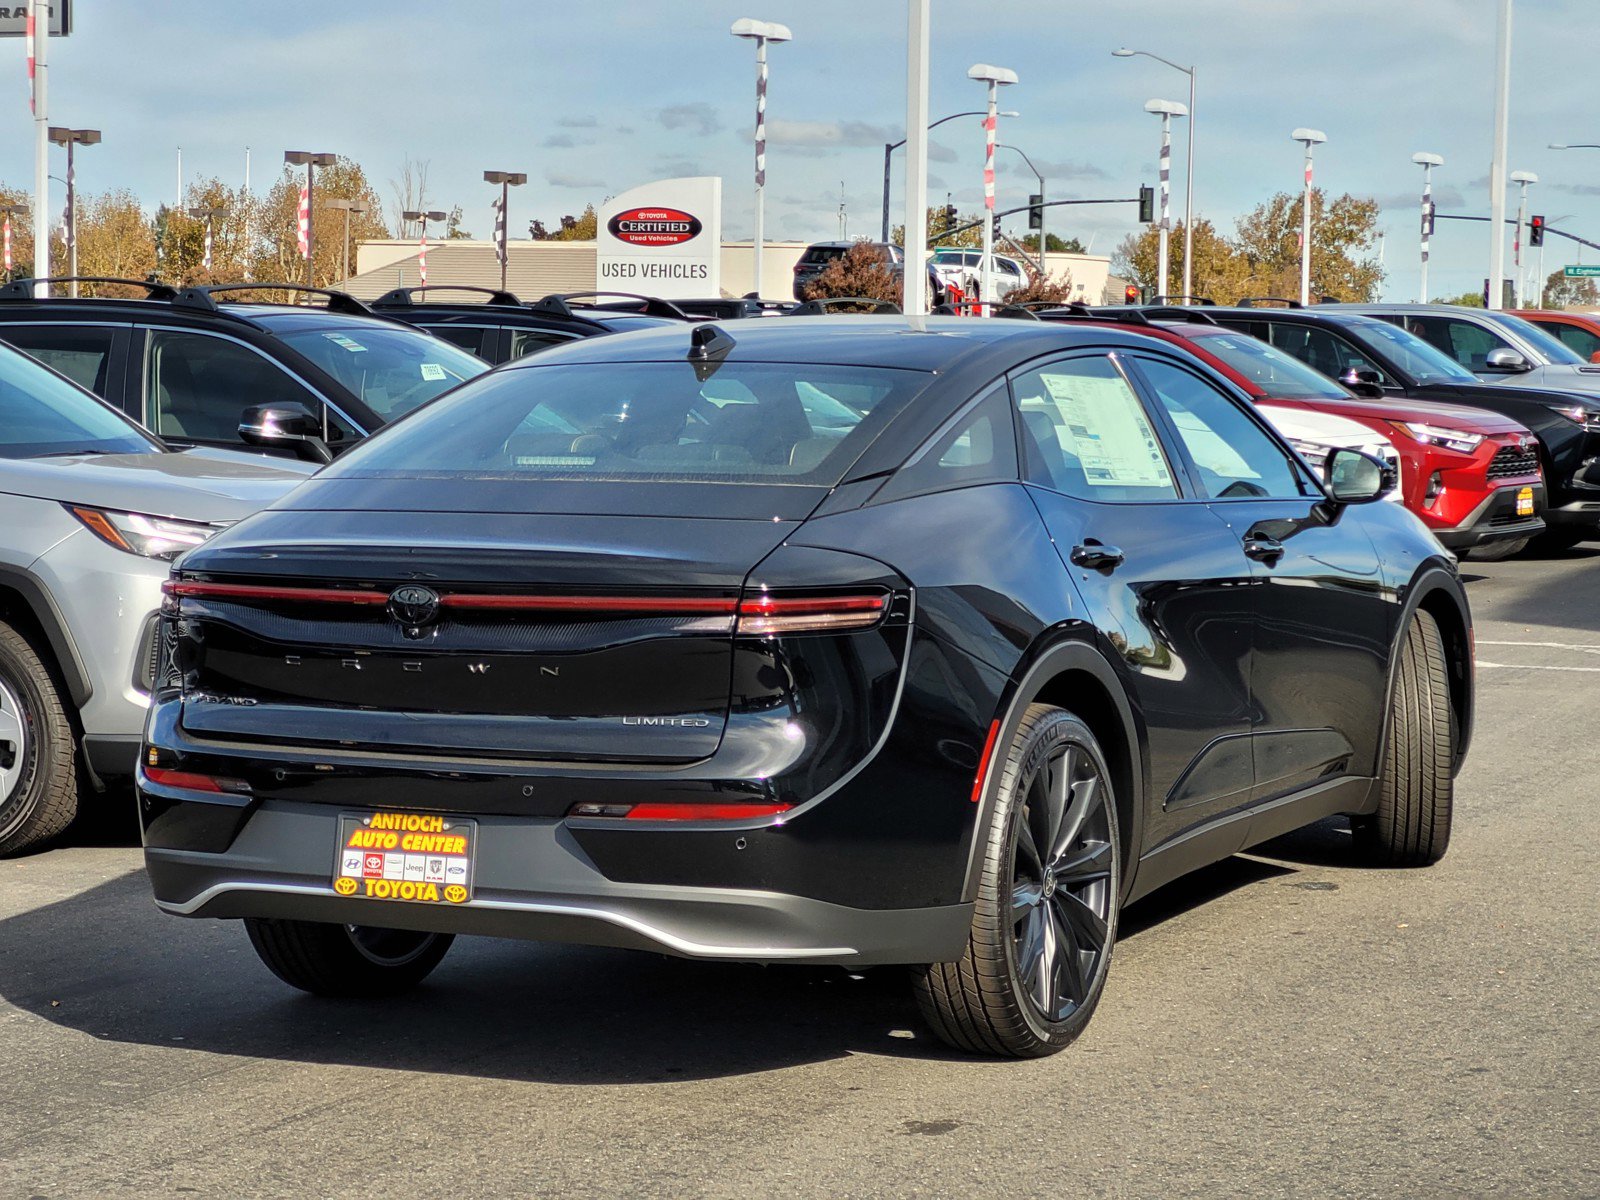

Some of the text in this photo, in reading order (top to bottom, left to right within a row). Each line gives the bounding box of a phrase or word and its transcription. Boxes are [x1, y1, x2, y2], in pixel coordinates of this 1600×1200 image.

[619, 221, 690, 232] CERTIFIED
[602, 263, 708, 279] USED VEHICLES
[622, 716, 710, 727] LIMITED
[369, 813, 443, 832] ANTIOCH
[347, 829, 467, 854] AUTO CENTER
[405, 863, 424, 874] Jeep
[364, 879, 441, 902] TOYOTA
